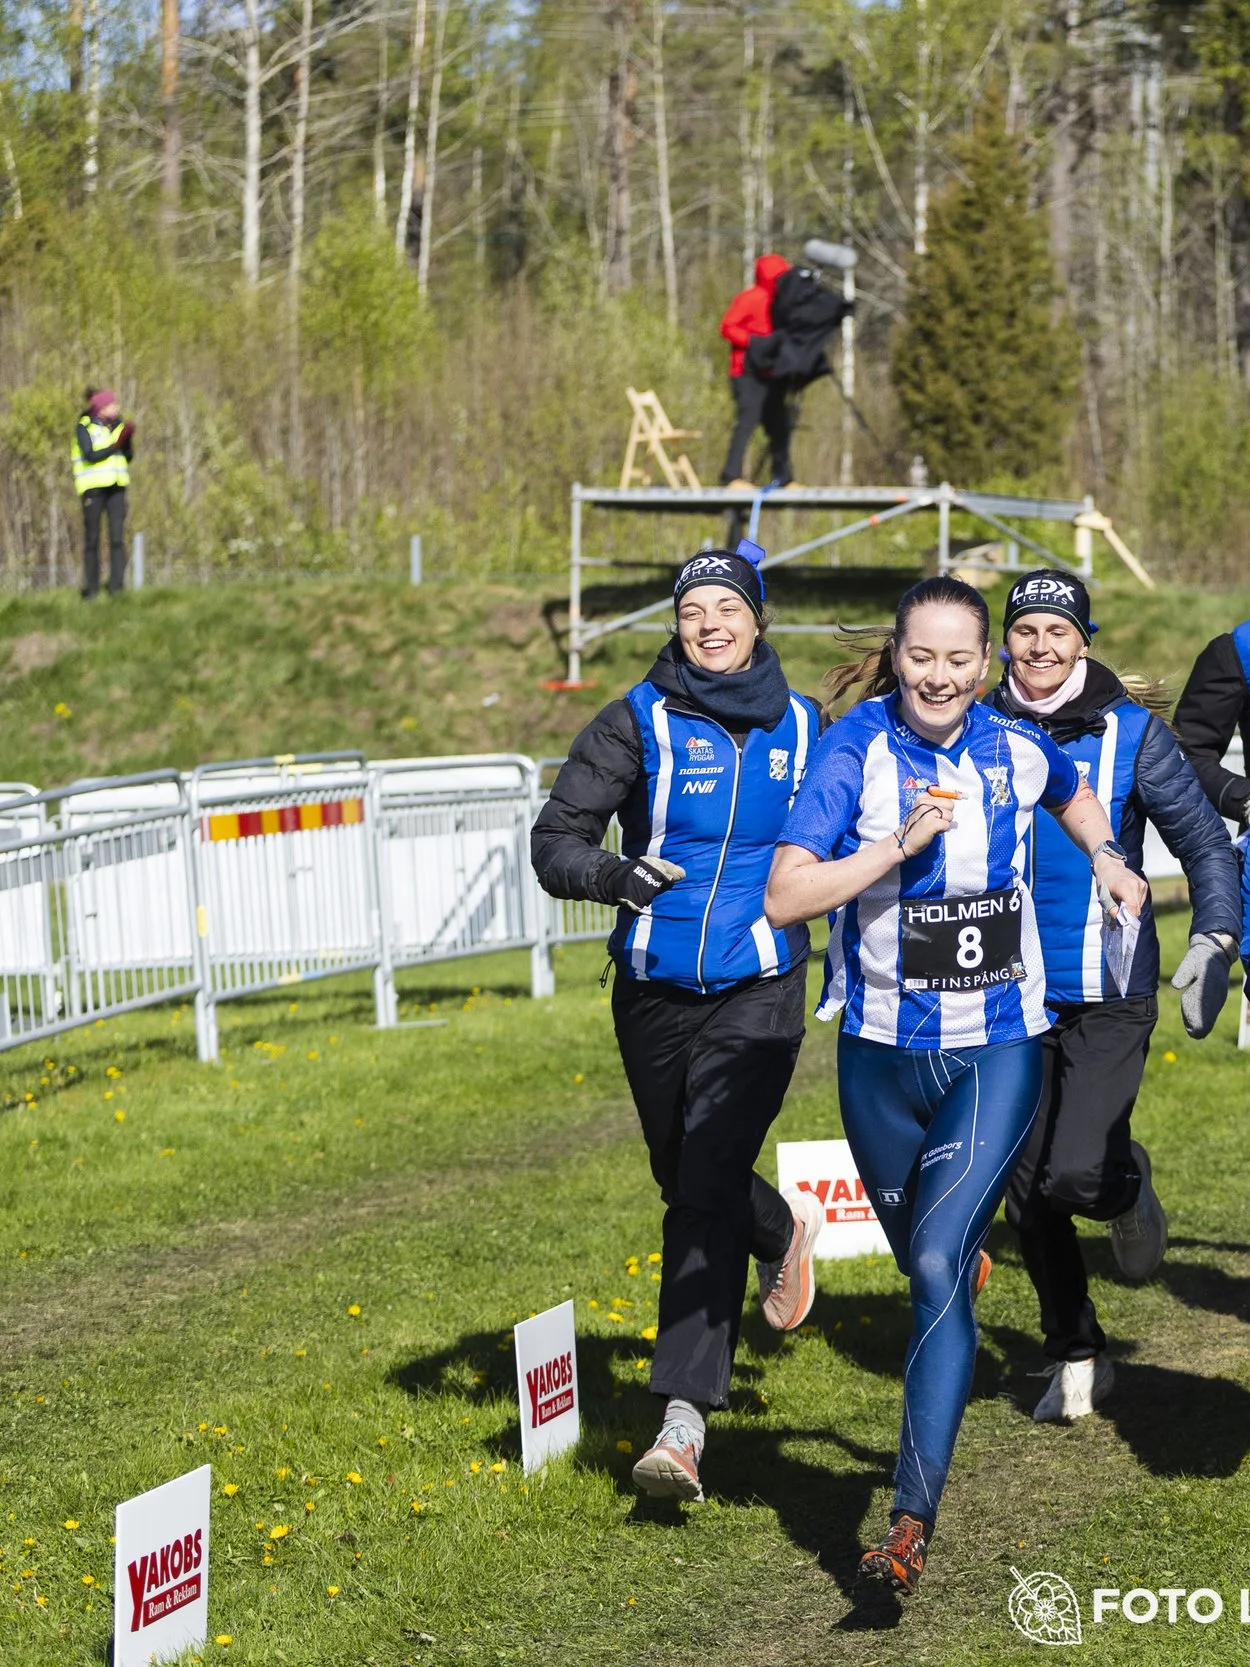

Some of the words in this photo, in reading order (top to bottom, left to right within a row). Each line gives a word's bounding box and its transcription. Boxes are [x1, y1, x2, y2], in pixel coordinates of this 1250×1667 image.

[1012, 579, 1075, 602] LEDX
[1016, 594, 1068, 605] LIGHTS
[688, 746, 714, 756] SKATÅS
[689, 754, 715, 762] RYGGAR
[678, 766, 725, 776] noname
[908, 897, 1004, 923] HOLMEN
[956, 926, 984, 969] 8
[932, 968, 1010, 988] FINSPÅNG
[928, 1141, 964, 1157] Göteborg
[836, 1208, 865, 1221] Ram
[526, 1350, 573, 1429] YAKOBS
[127, 1528, 202, 1632] YAKOBS
[148, 1600, 164, 1619] Ram
[165, 1594, 173, 1609] &
[173, 1583, 197, 1606] Reklam
